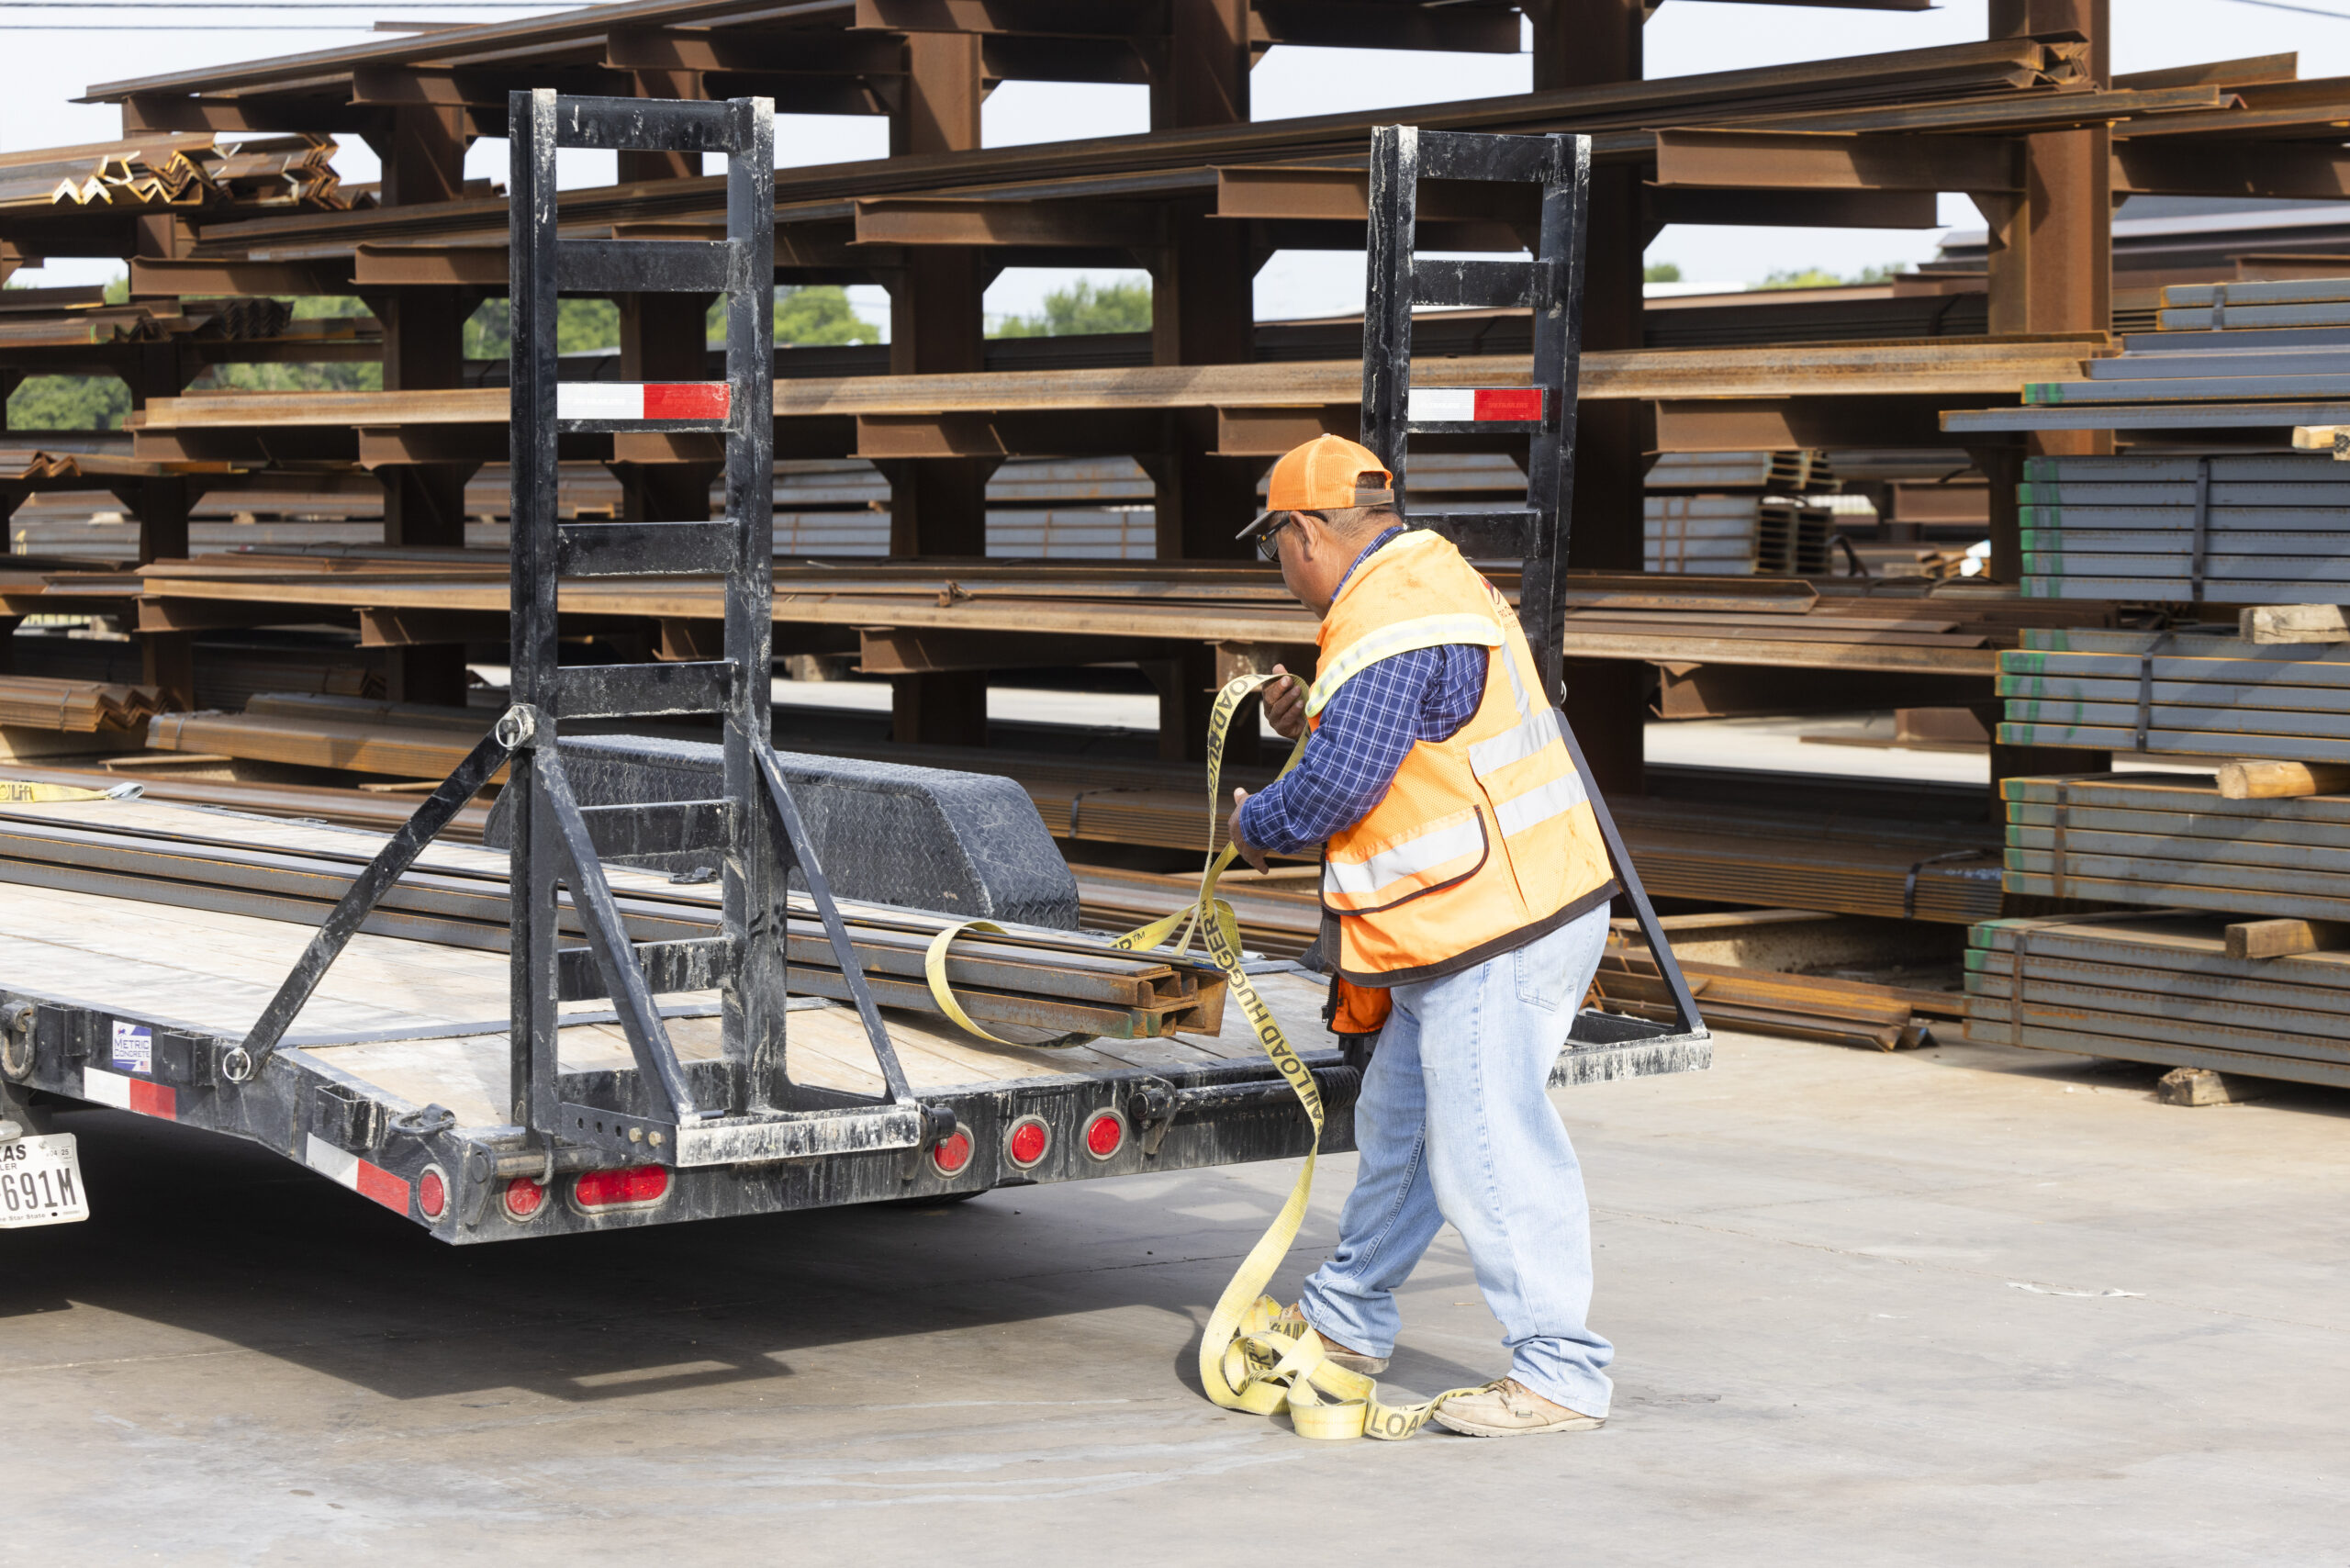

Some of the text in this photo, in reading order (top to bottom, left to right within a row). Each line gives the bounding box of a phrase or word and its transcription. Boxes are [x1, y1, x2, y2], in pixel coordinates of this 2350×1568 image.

[114, 1038, 150, 1049] METRIC
[114, 1049, 151, 1058] CONCRETE
[1260, 1025, 1312, 1090] LOAD
[0, 1144, 27, 1162] AS
